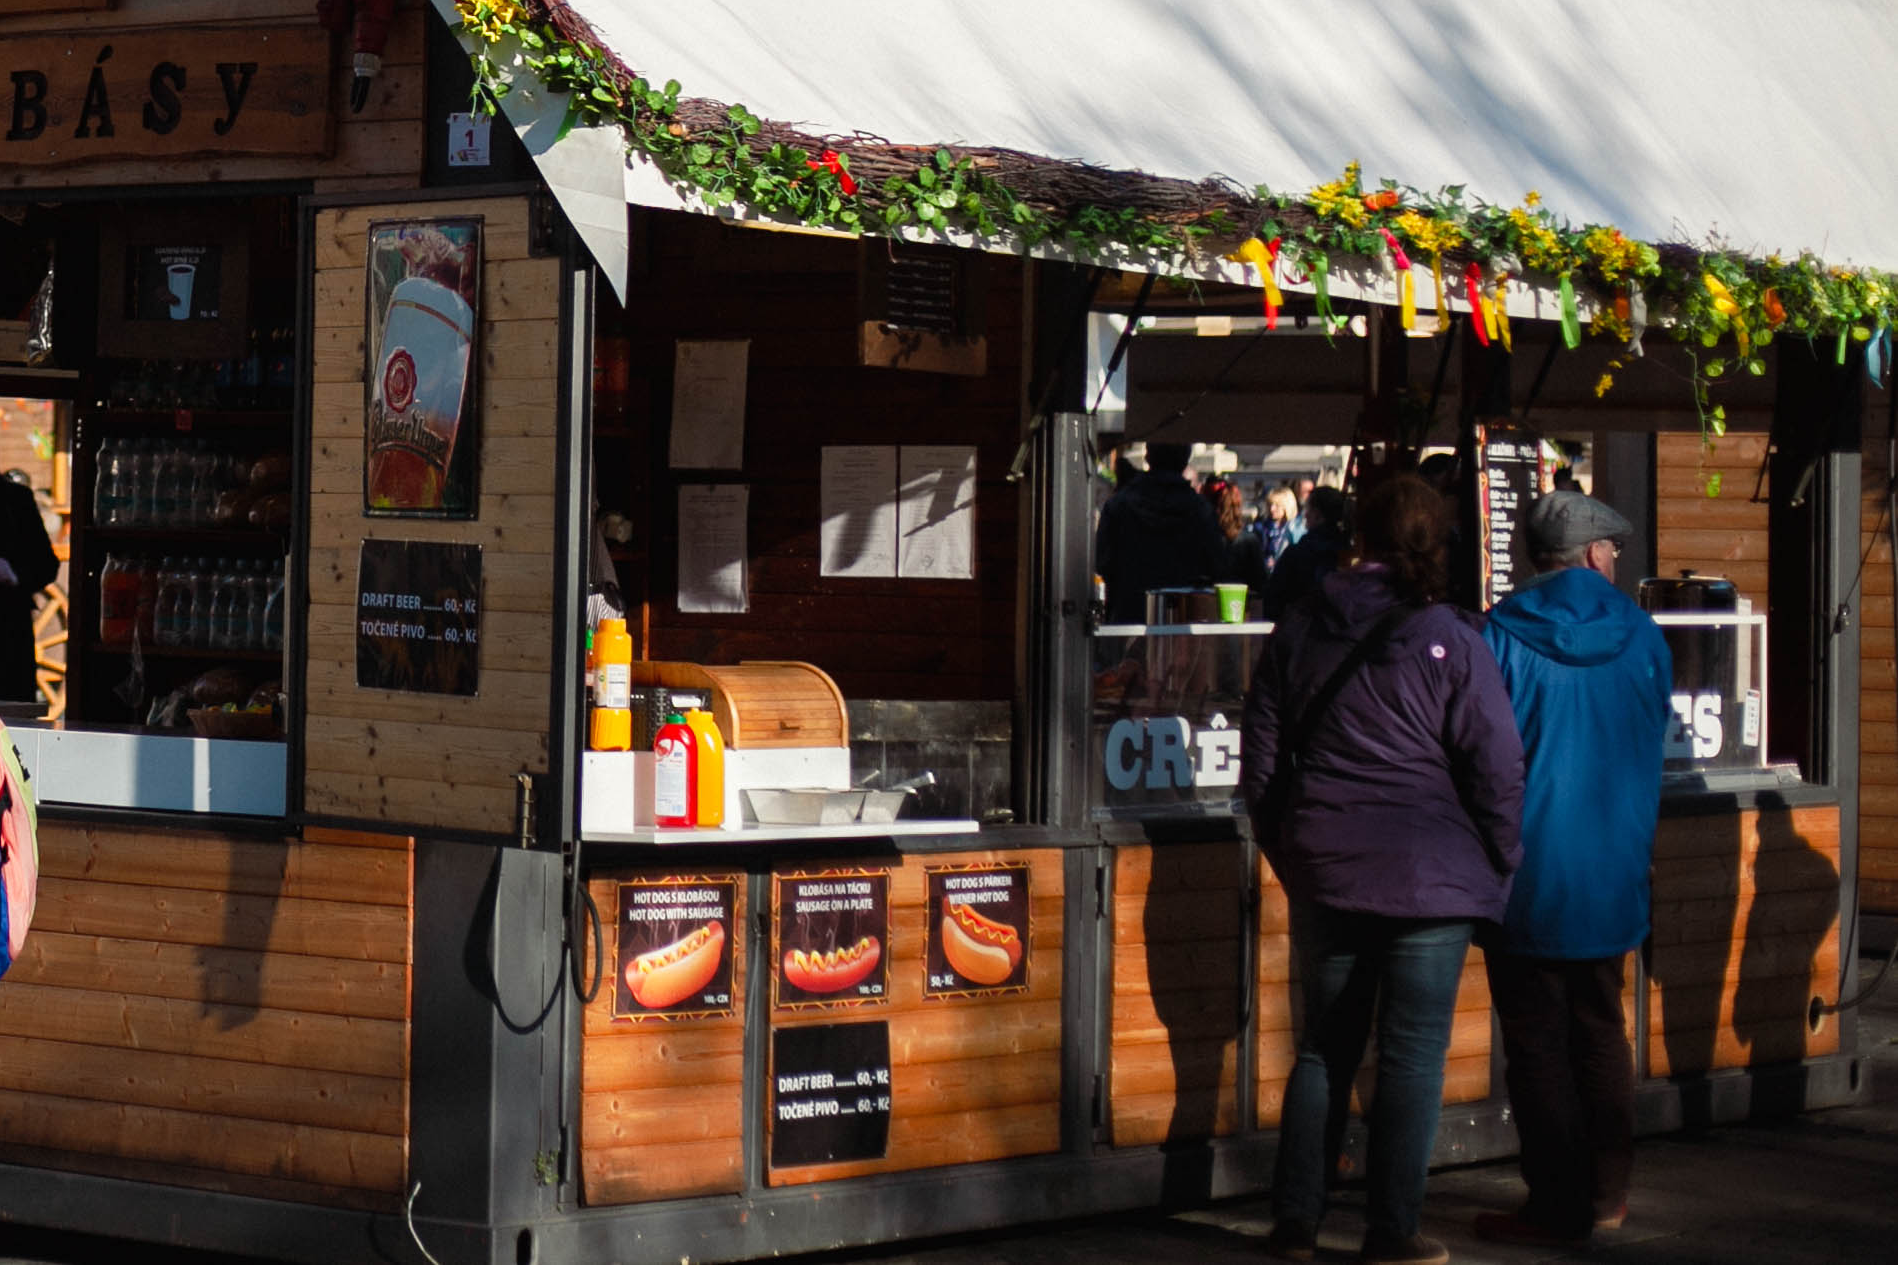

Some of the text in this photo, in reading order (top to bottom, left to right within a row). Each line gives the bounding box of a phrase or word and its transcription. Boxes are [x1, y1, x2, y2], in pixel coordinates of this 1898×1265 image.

[465, 129, 475, 148] 1
[361, 592, 395, 608] DRAFT
[395, 594, 421, 610] BEER
[361, 619, 399, 638] TOČENÉ
[401, 623, 425, 639] PIVO
[798, 881, 871, 897] KLOBÁSA NA TÁCKU
[945, 878, 961, 890] HOT
[962, 877, 978, 889] DOG
[978, 877, 984, 888] S
[634, 889, 720, 904] HOT DOG S KLOBÁSOU
[948, 891, 1009, 905] WIENER HOT DOG
[629, 906, 724, 921] HOT DOG WITH SAUSAGE
[795, 898, 873, 913] SAUSAGE ON A PLATE
[778, 1076, 810, 1094] DRAFT
[810, 1073, 834, 1091] BEER
[876, 1069, 889, 1084] Kč
[778, 1100, 814, 1121] TOČENÉ
[814, 1100, 839, 1117] PIVO
[877, 1096, 890, 1112] Kč
